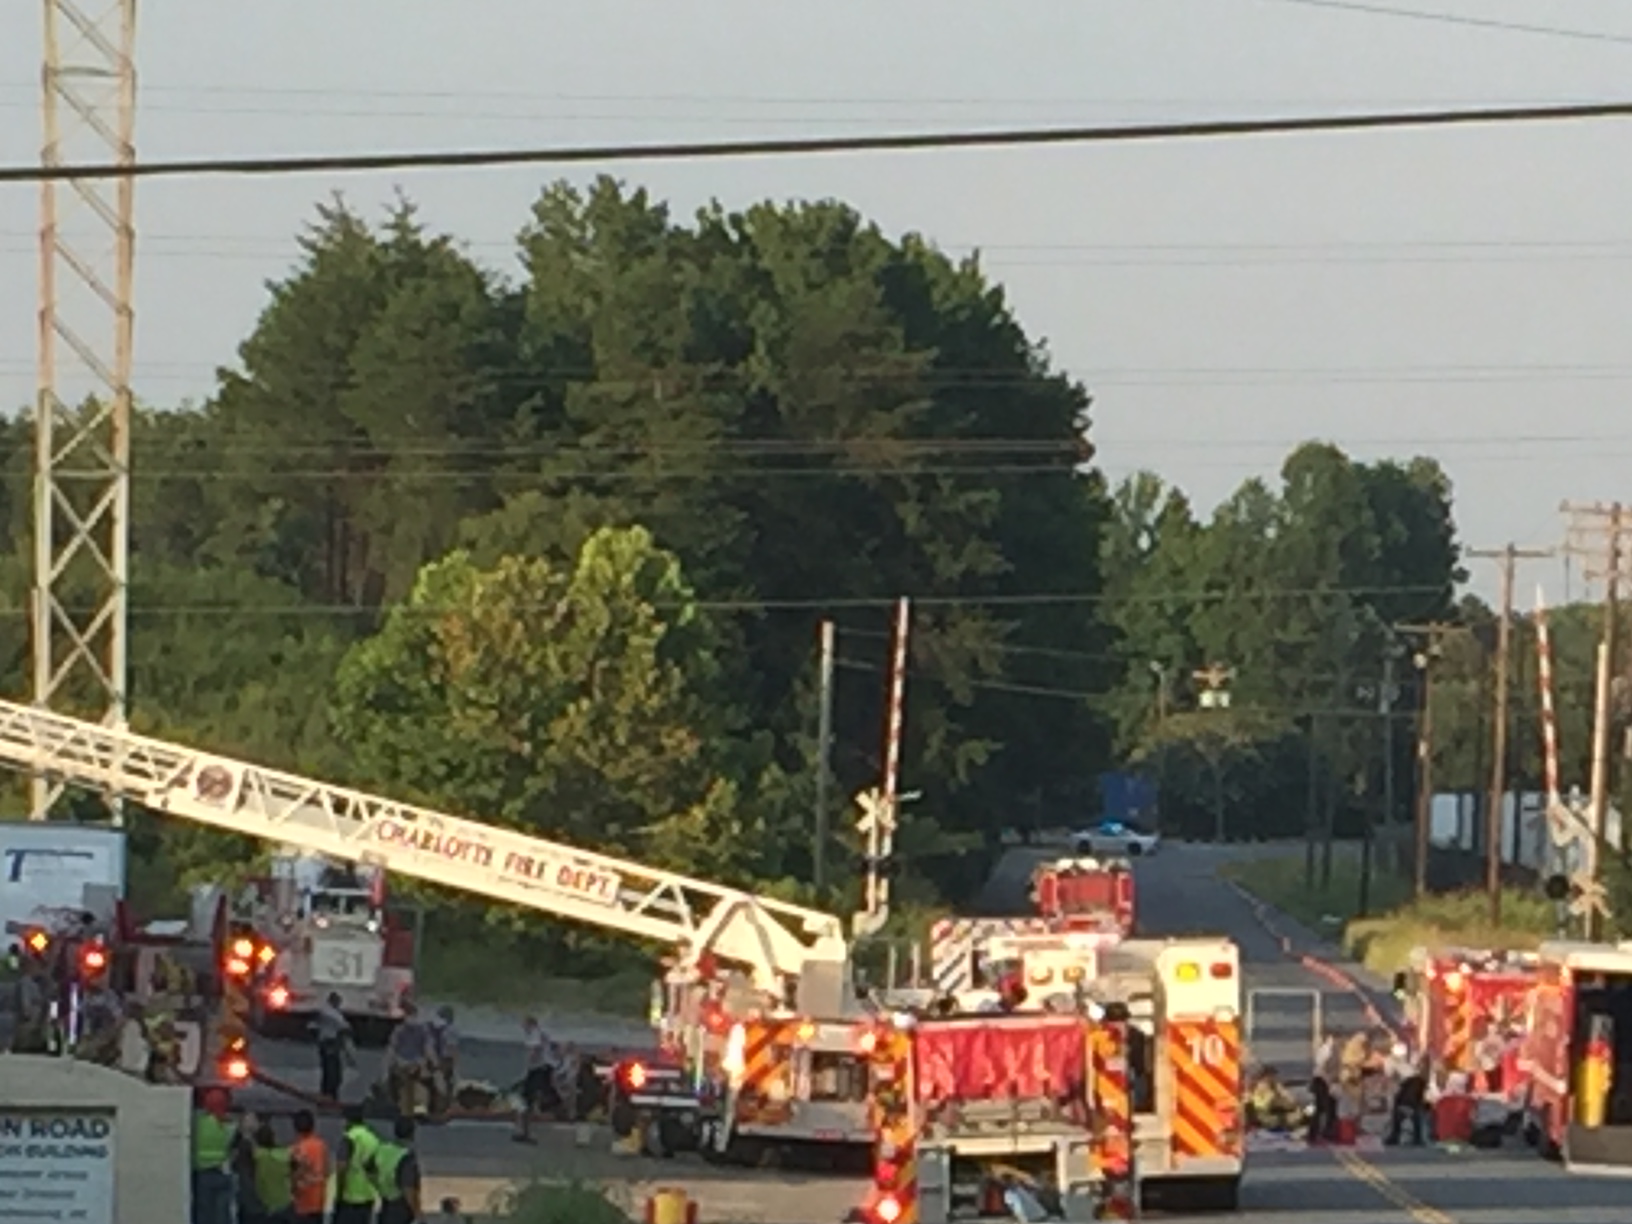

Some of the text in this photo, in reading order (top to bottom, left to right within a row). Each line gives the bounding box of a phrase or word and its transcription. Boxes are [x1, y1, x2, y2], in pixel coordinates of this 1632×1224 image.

[377, 819, 493, 867] CHARLOTTE
[503, 851, 549, 880] FIRE
[327, 946, 363, 979] 31
[1185, 1034, 1226, 1067] 10
[29, 1117, 111, 1140] ROAD
